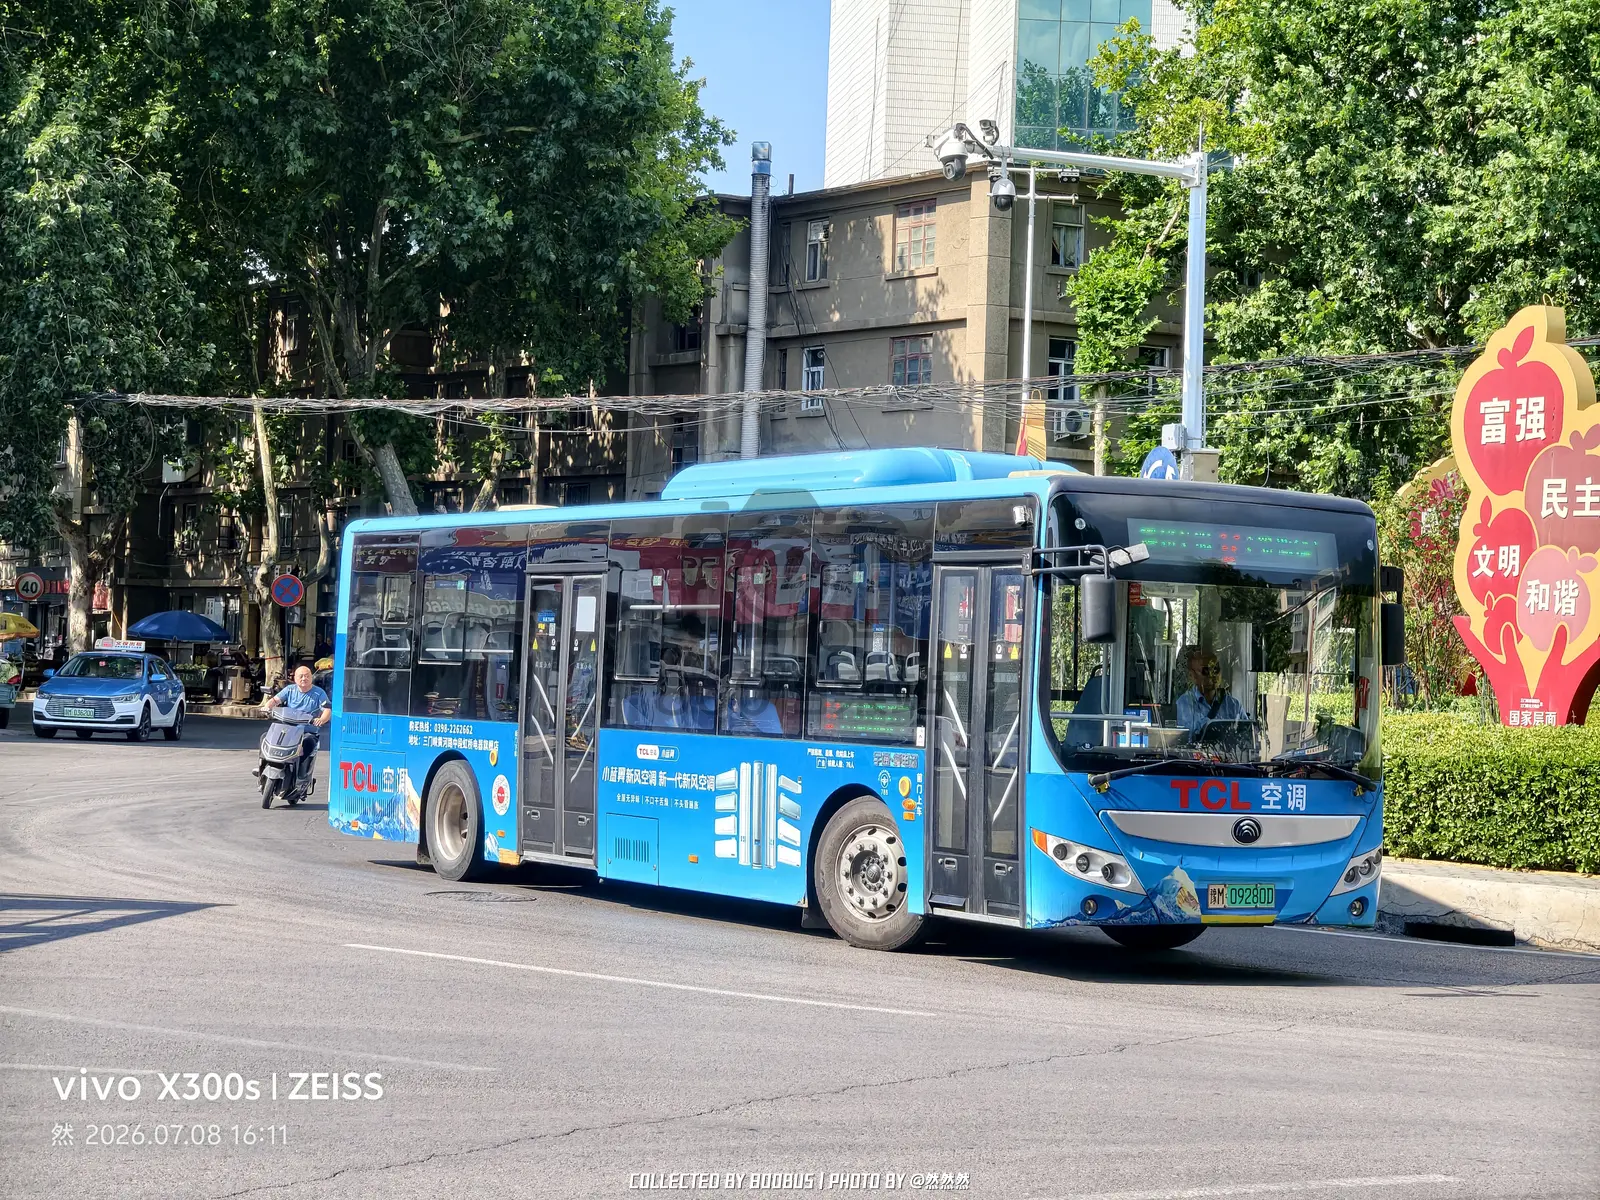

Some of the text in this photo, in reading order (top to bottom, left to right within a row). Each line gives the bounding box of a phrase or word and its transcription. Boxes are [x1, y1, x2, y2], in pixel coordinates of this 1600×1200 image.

[1480, 397, 1547, 444] 富强
[1541, 477, 1600, 518] 民主
[1472, 545, 1521, 577] 文明
[22, 581, 38, 593] 40
[1525, 579, 1580, 615] 和谐
[434, 723, 473, 734] 0398-2262662
[1509, 711, 1557, 726] 国家层面
[339, 761, 408, 794] TCL 空调
[602, 766, 715, 792] 小蓝翼新风空调 新一代新风空调
[1170, 779, 1307, 811] TCL 空调
